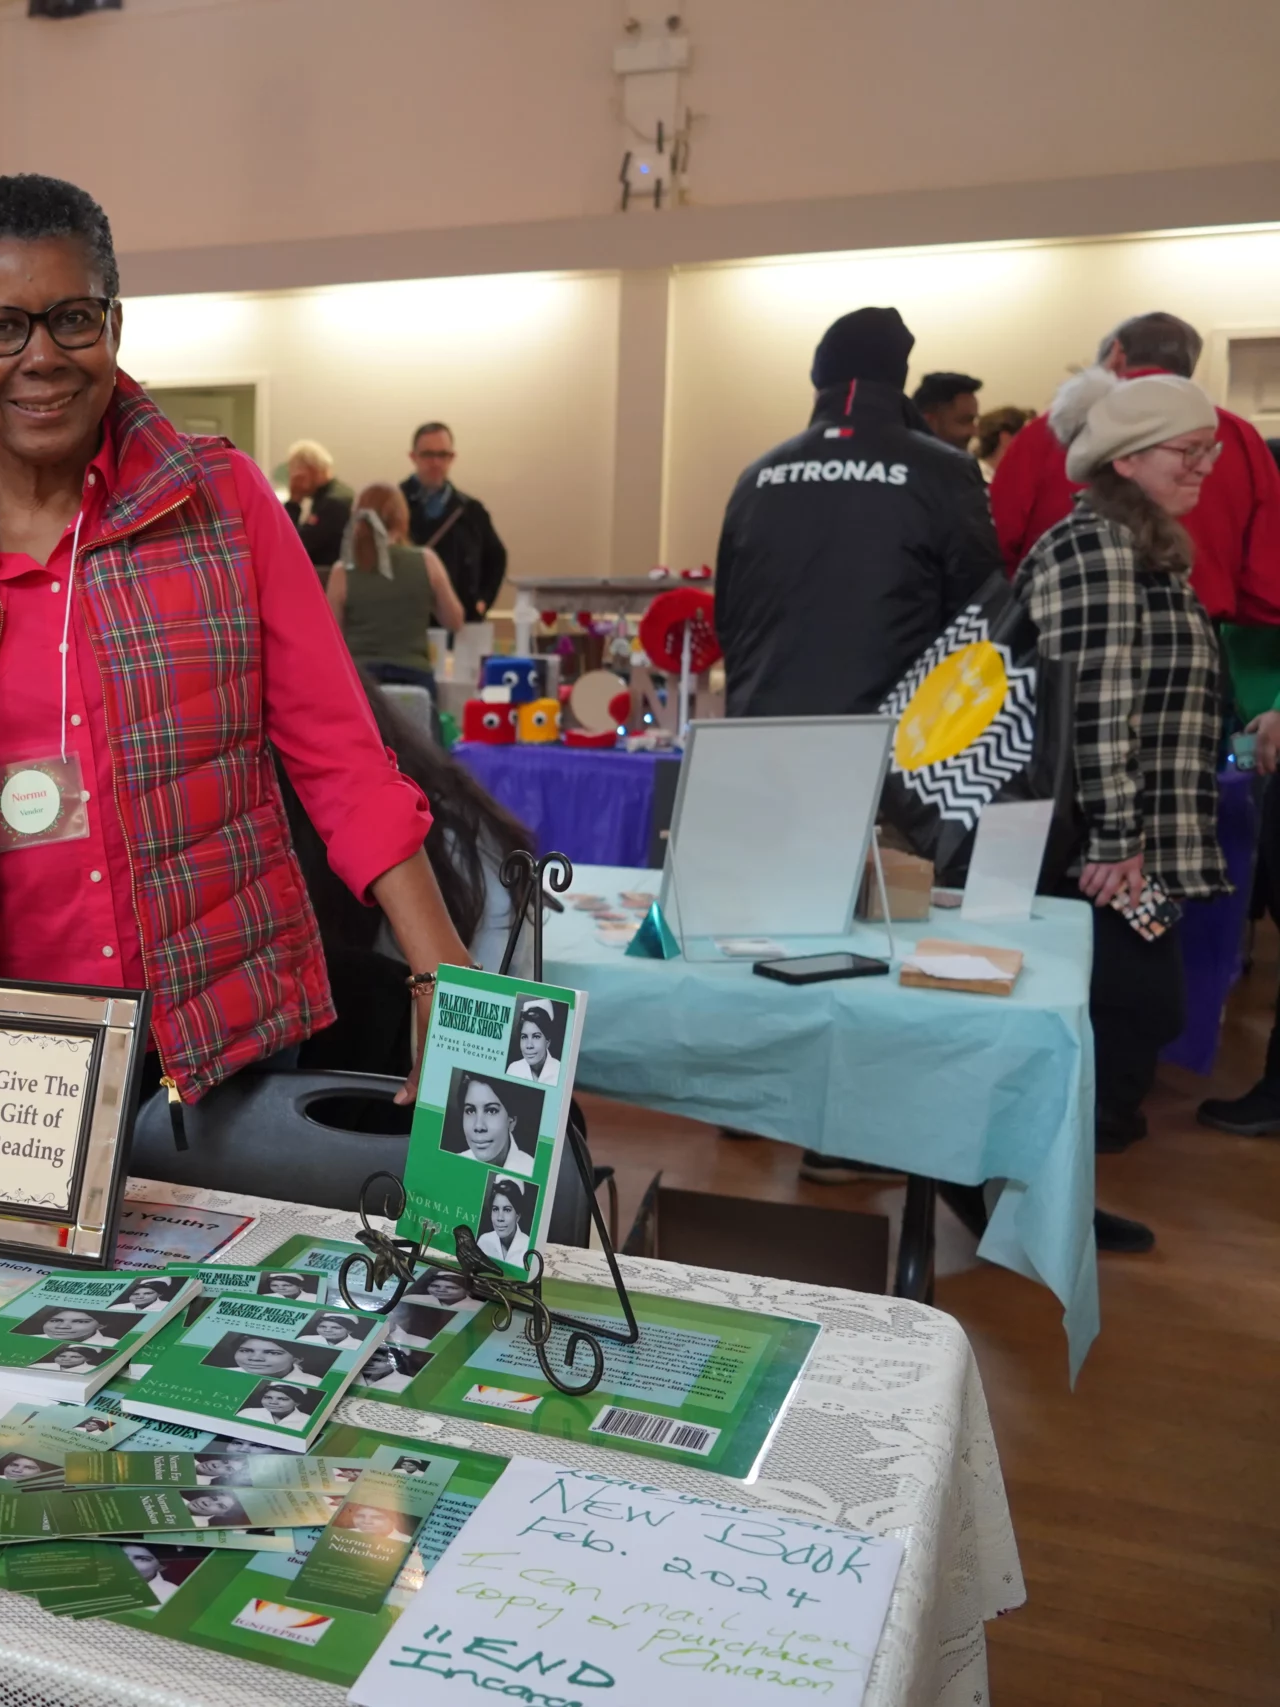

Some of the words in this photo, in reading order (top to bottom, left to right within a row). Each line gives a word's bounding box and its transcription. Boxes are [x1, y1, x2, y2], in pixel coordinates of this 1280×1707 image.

[756, 457, 909, 489] PETRONAS
[12, 789, 47, 803] Norma
[20, 806, 44, 817] Vendor
[438, 992, 474, 1016] WALKING
[474, 1000, 500, 1021] MILES
[500, 1006, 511, 1024] IN
[438, 1010, 477, 1034] SENSIBLE
[477, 1018, 504, 1040] SHOES
[44, 1074, 80, 1099] The
[0, 1102, 38, 1128] Gift
[42, 1106, 64, 1129] of
[140, 1212, 220, 1231] Youth?
[36, 1267, 52, 1276] to
[214, 1272, 246, 1283] MILES
[246, 1274, 256, 1282] IN
[40, 1285, 82, 1296] SENSIBLE
[81, 1288, 115, 1297] SHOES
[45, 1279, 86, 1290] WALKING
[86, 1282, 114, 1293] MILES
[114, 1283, 126, 1291] IN
[220, 1278, 250, 1288] SHOES
[216, 1308, 264, 1321] SENSIBLE
[264, 1314, 298, 1326] SHOES
[218, 1300, 262, 1314] WALKING
[263, 1306, 295, 1318] MILES
[152, 1420, 202, 1440] SHOES
[154, 1456, 166, 1480] Nicholson
[169, 1454, 180, 1472] Norma
[169, 1472, 182, 1482] Fay
[370, 1468, 410, 1482] WALKING
[410, 1478, 440, 1488] MILES
[140, 1496, 159, 1524] Nicholson
[154, 1494, 170, 1514] Norma
[164, 1514, 176, 1525] Fay
[555, 1469, 668, 1495] Leave
[655, 1494, 763, 1515] your
[778, 1516, 882, 1547] card
[328, 1542, 391, 1562] Nicholson
[330, 1533, 374, 1550] Norma
[375, 1544, 396, 1556] Fay
[516, 1515, 628, 1556] Feb.
[662, 1556, 822, 1609] 2024
[456, 1551, 521, 1571] I
[519, 1568, 602, 1601] can
[622, 1601, 741, 1632] mail
[766, 1626, 855, 1658] you
[456, 1581, 564, 1630] copy
[586, 1614, 631, 1631] or
[637, 1628, 862, 1673] purchase
